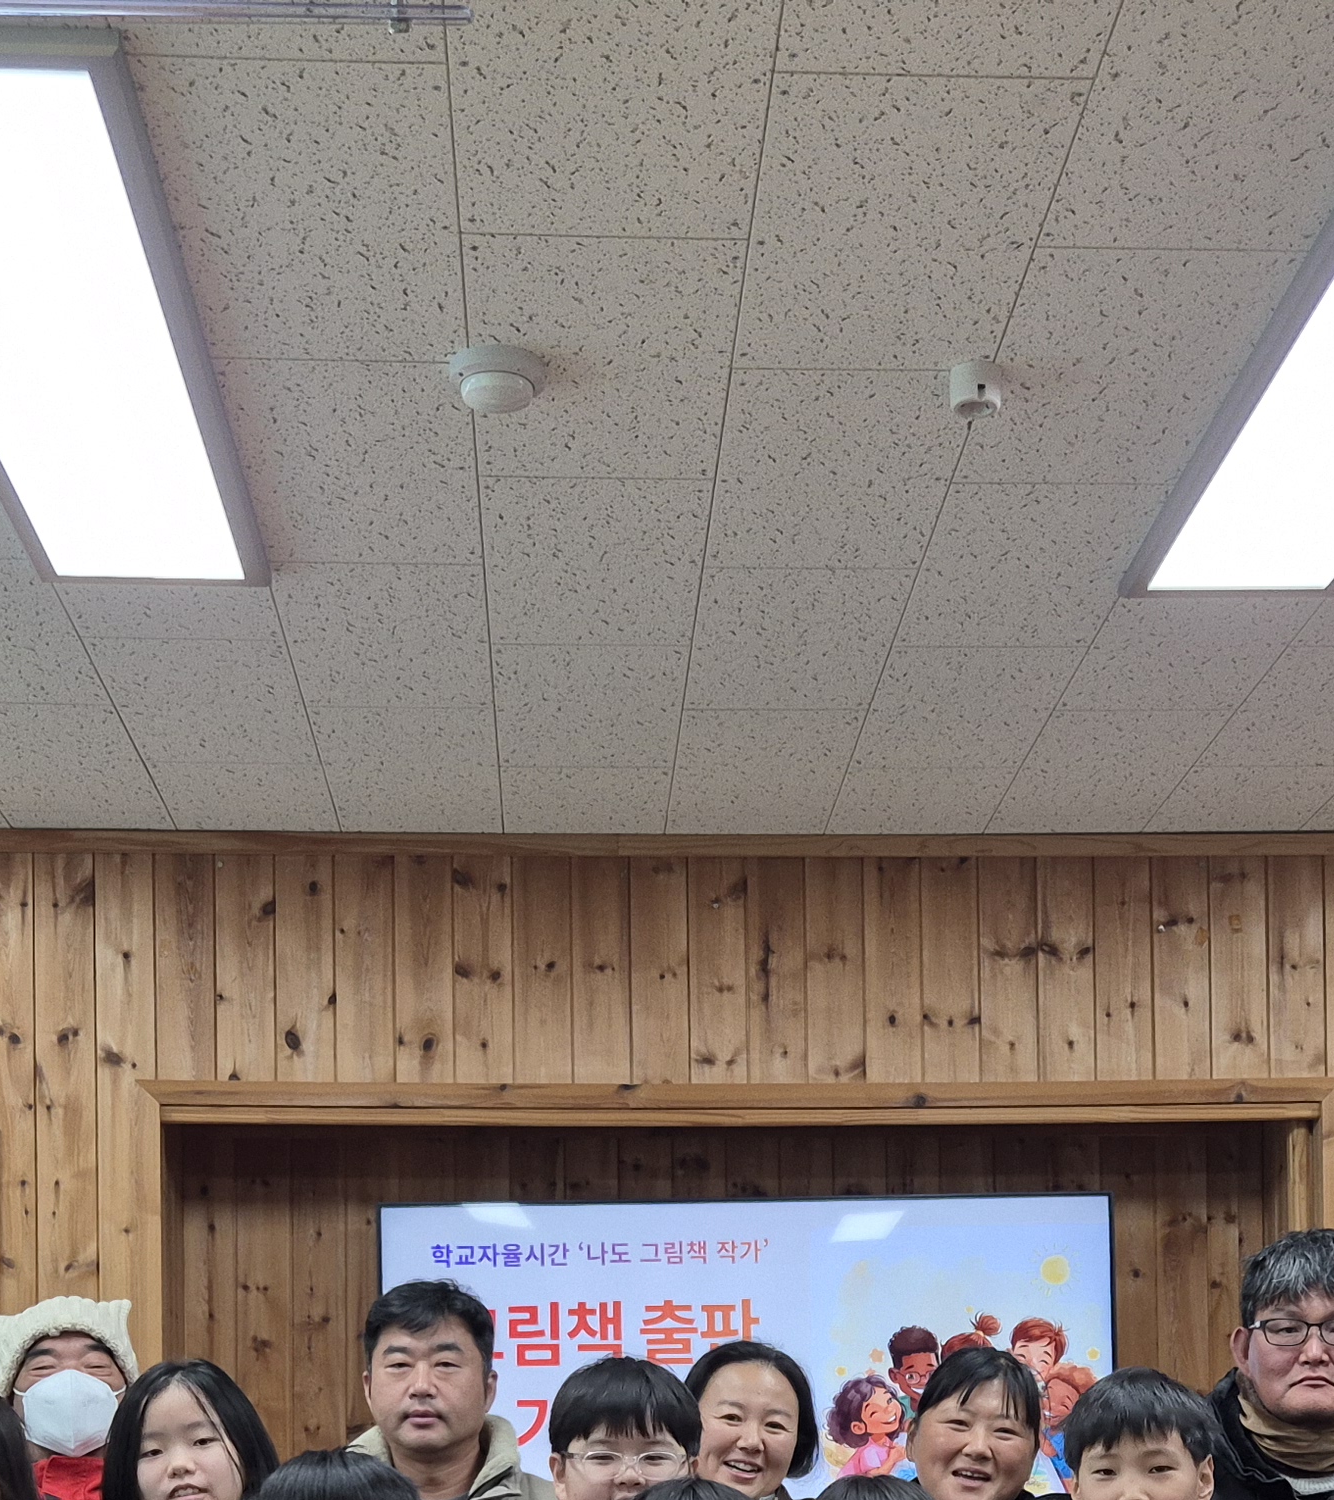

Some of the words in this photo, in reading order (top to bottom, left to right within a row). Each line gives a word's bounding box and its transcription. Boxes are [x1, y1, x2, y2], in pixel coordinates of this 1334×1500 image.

[430, 1242, 570, 1268] 학교자율시간
[639, 1240, 710, 1265] 그림책
[639, 1298, 760, 1365] 출판
